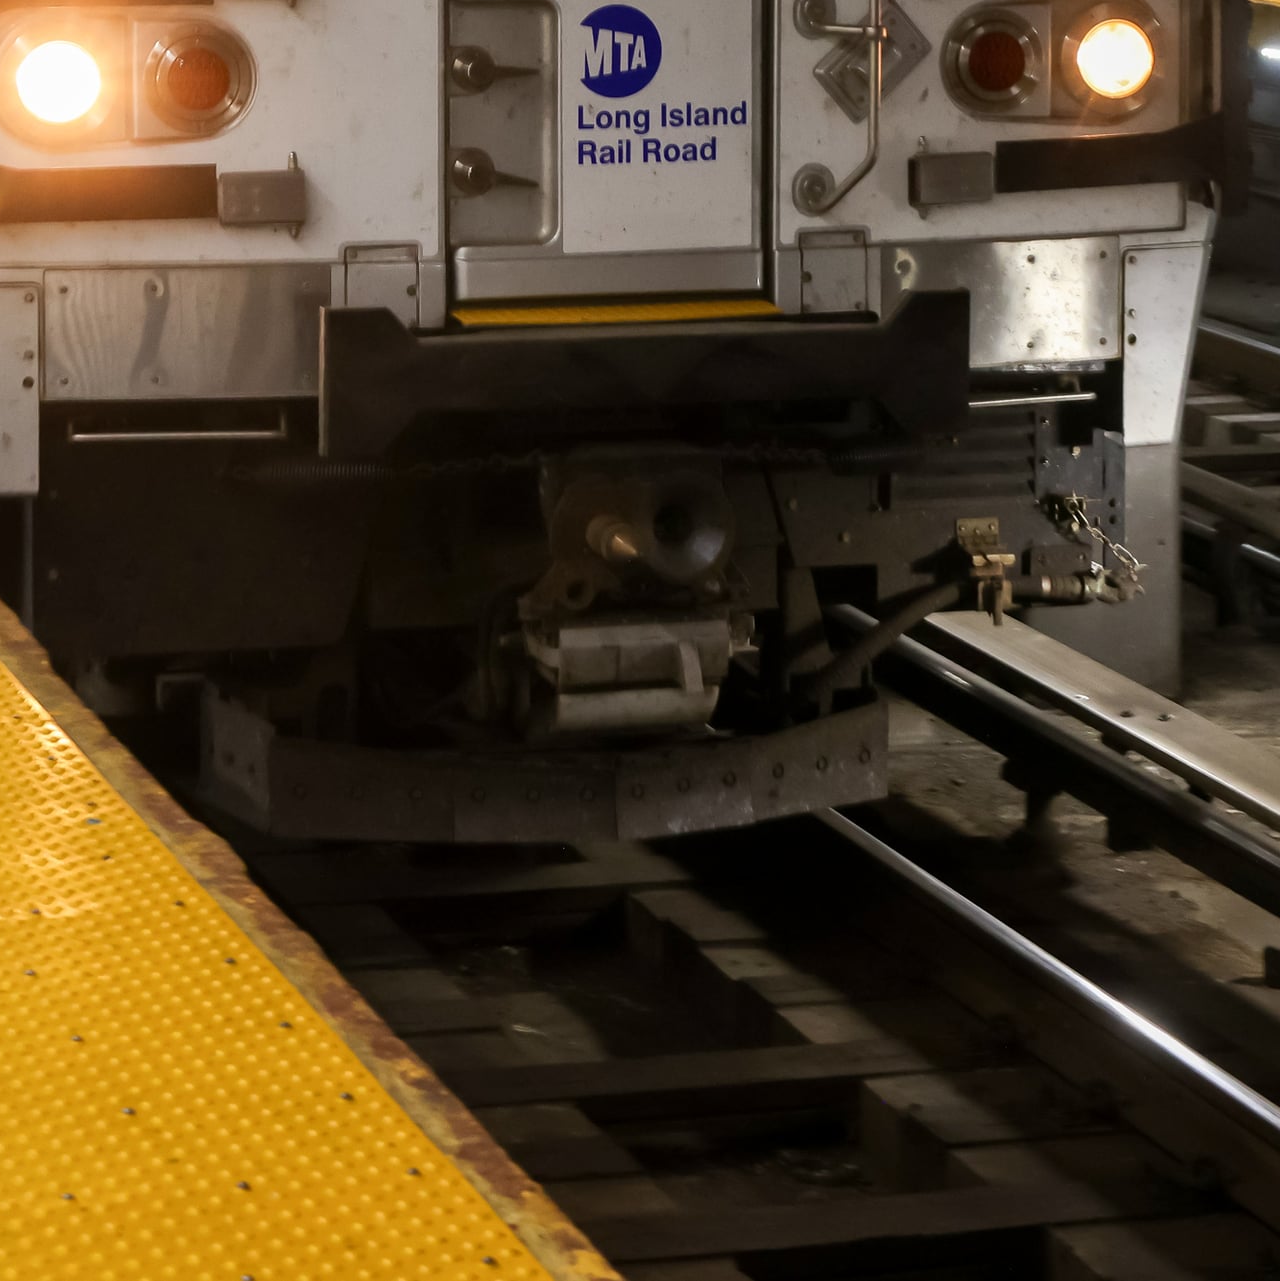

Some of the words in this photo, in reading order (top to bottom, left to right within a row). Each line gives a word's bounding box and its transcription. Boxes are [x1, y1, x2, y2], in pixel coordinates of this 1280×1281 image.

[579, 23, 649, 82] MTA
[577, 104, 651, 135] Long
[660, 100, 748, 128] Island
[577, 138, 632, 166] Rail
[642, 135, 718, 163] Road
